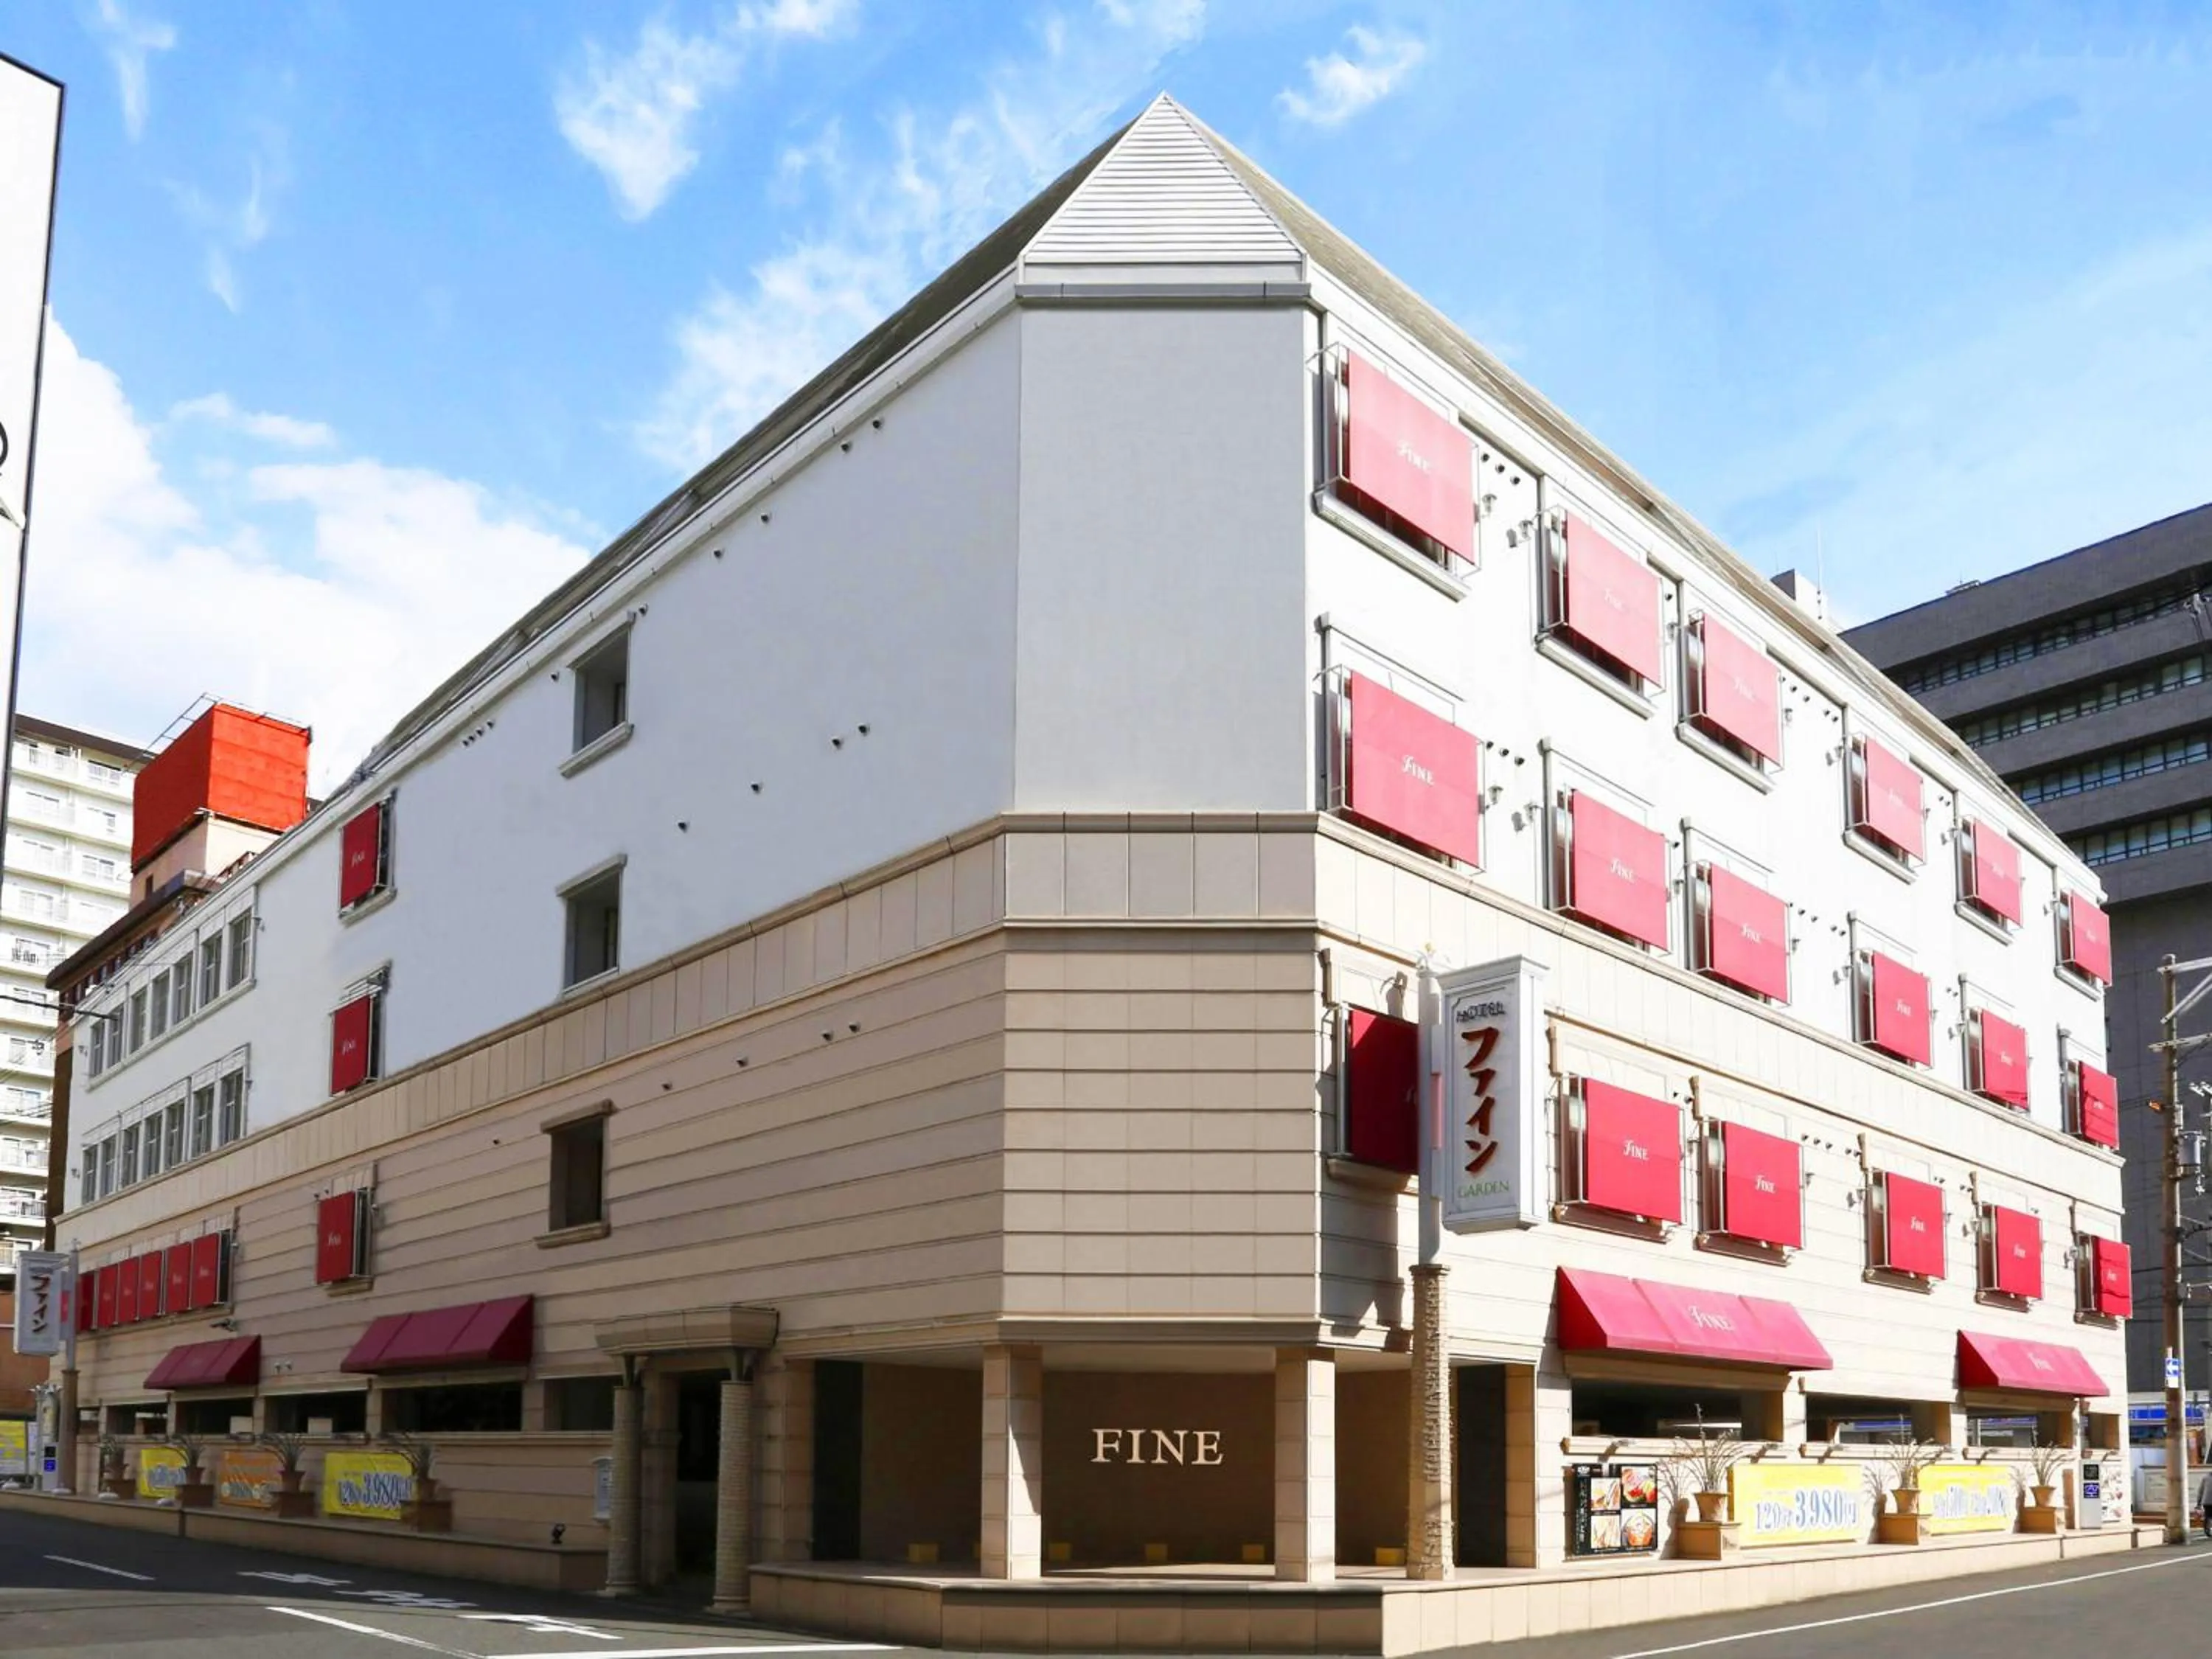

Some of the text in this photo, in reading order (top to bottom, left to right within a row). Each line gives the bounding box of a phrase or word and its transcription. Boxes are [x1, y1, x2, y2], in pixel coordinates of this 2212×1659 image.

[1402, 754, 1434, 786] FINE
[1461, 1026, 1500, 1175] ファイン
[1623, 1140, 1649, 1161] FINE
[1457, 1180, 1510, 1198] GARDEN
[1090, 1428, 1224, 1466] FINE
